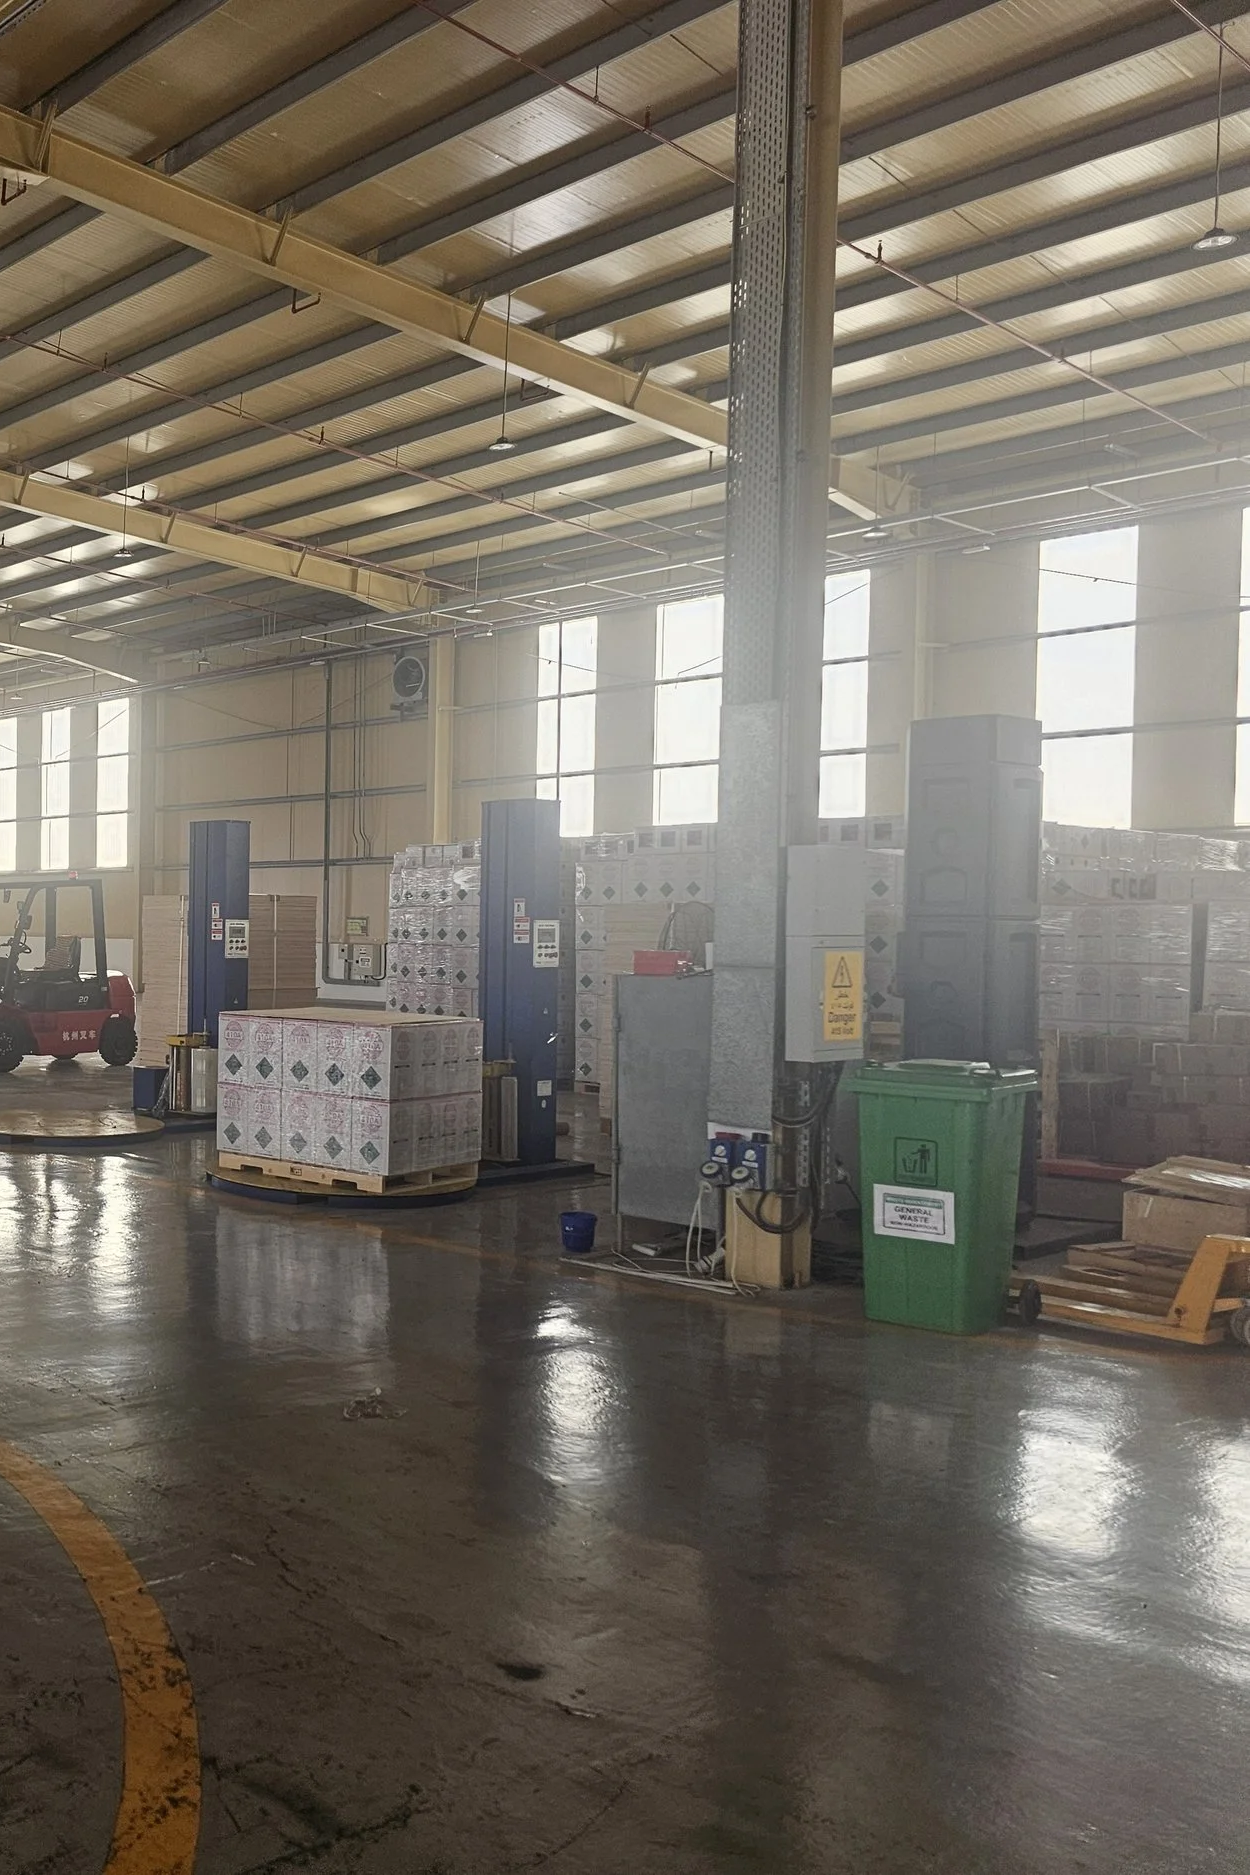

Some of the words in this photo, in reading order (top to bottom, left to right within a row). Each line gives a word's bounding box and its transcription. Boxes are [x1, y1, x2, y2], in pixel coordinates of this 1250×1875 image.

[78, 995, 89, 1003] 20
[828, 1011, 857, 1026] Danger
[62, 1029, 97, 1041] 杭州叉车
[894, 1205, 933, 1217] GENERAL
[899, 1214, 930, 1224] WASTE
